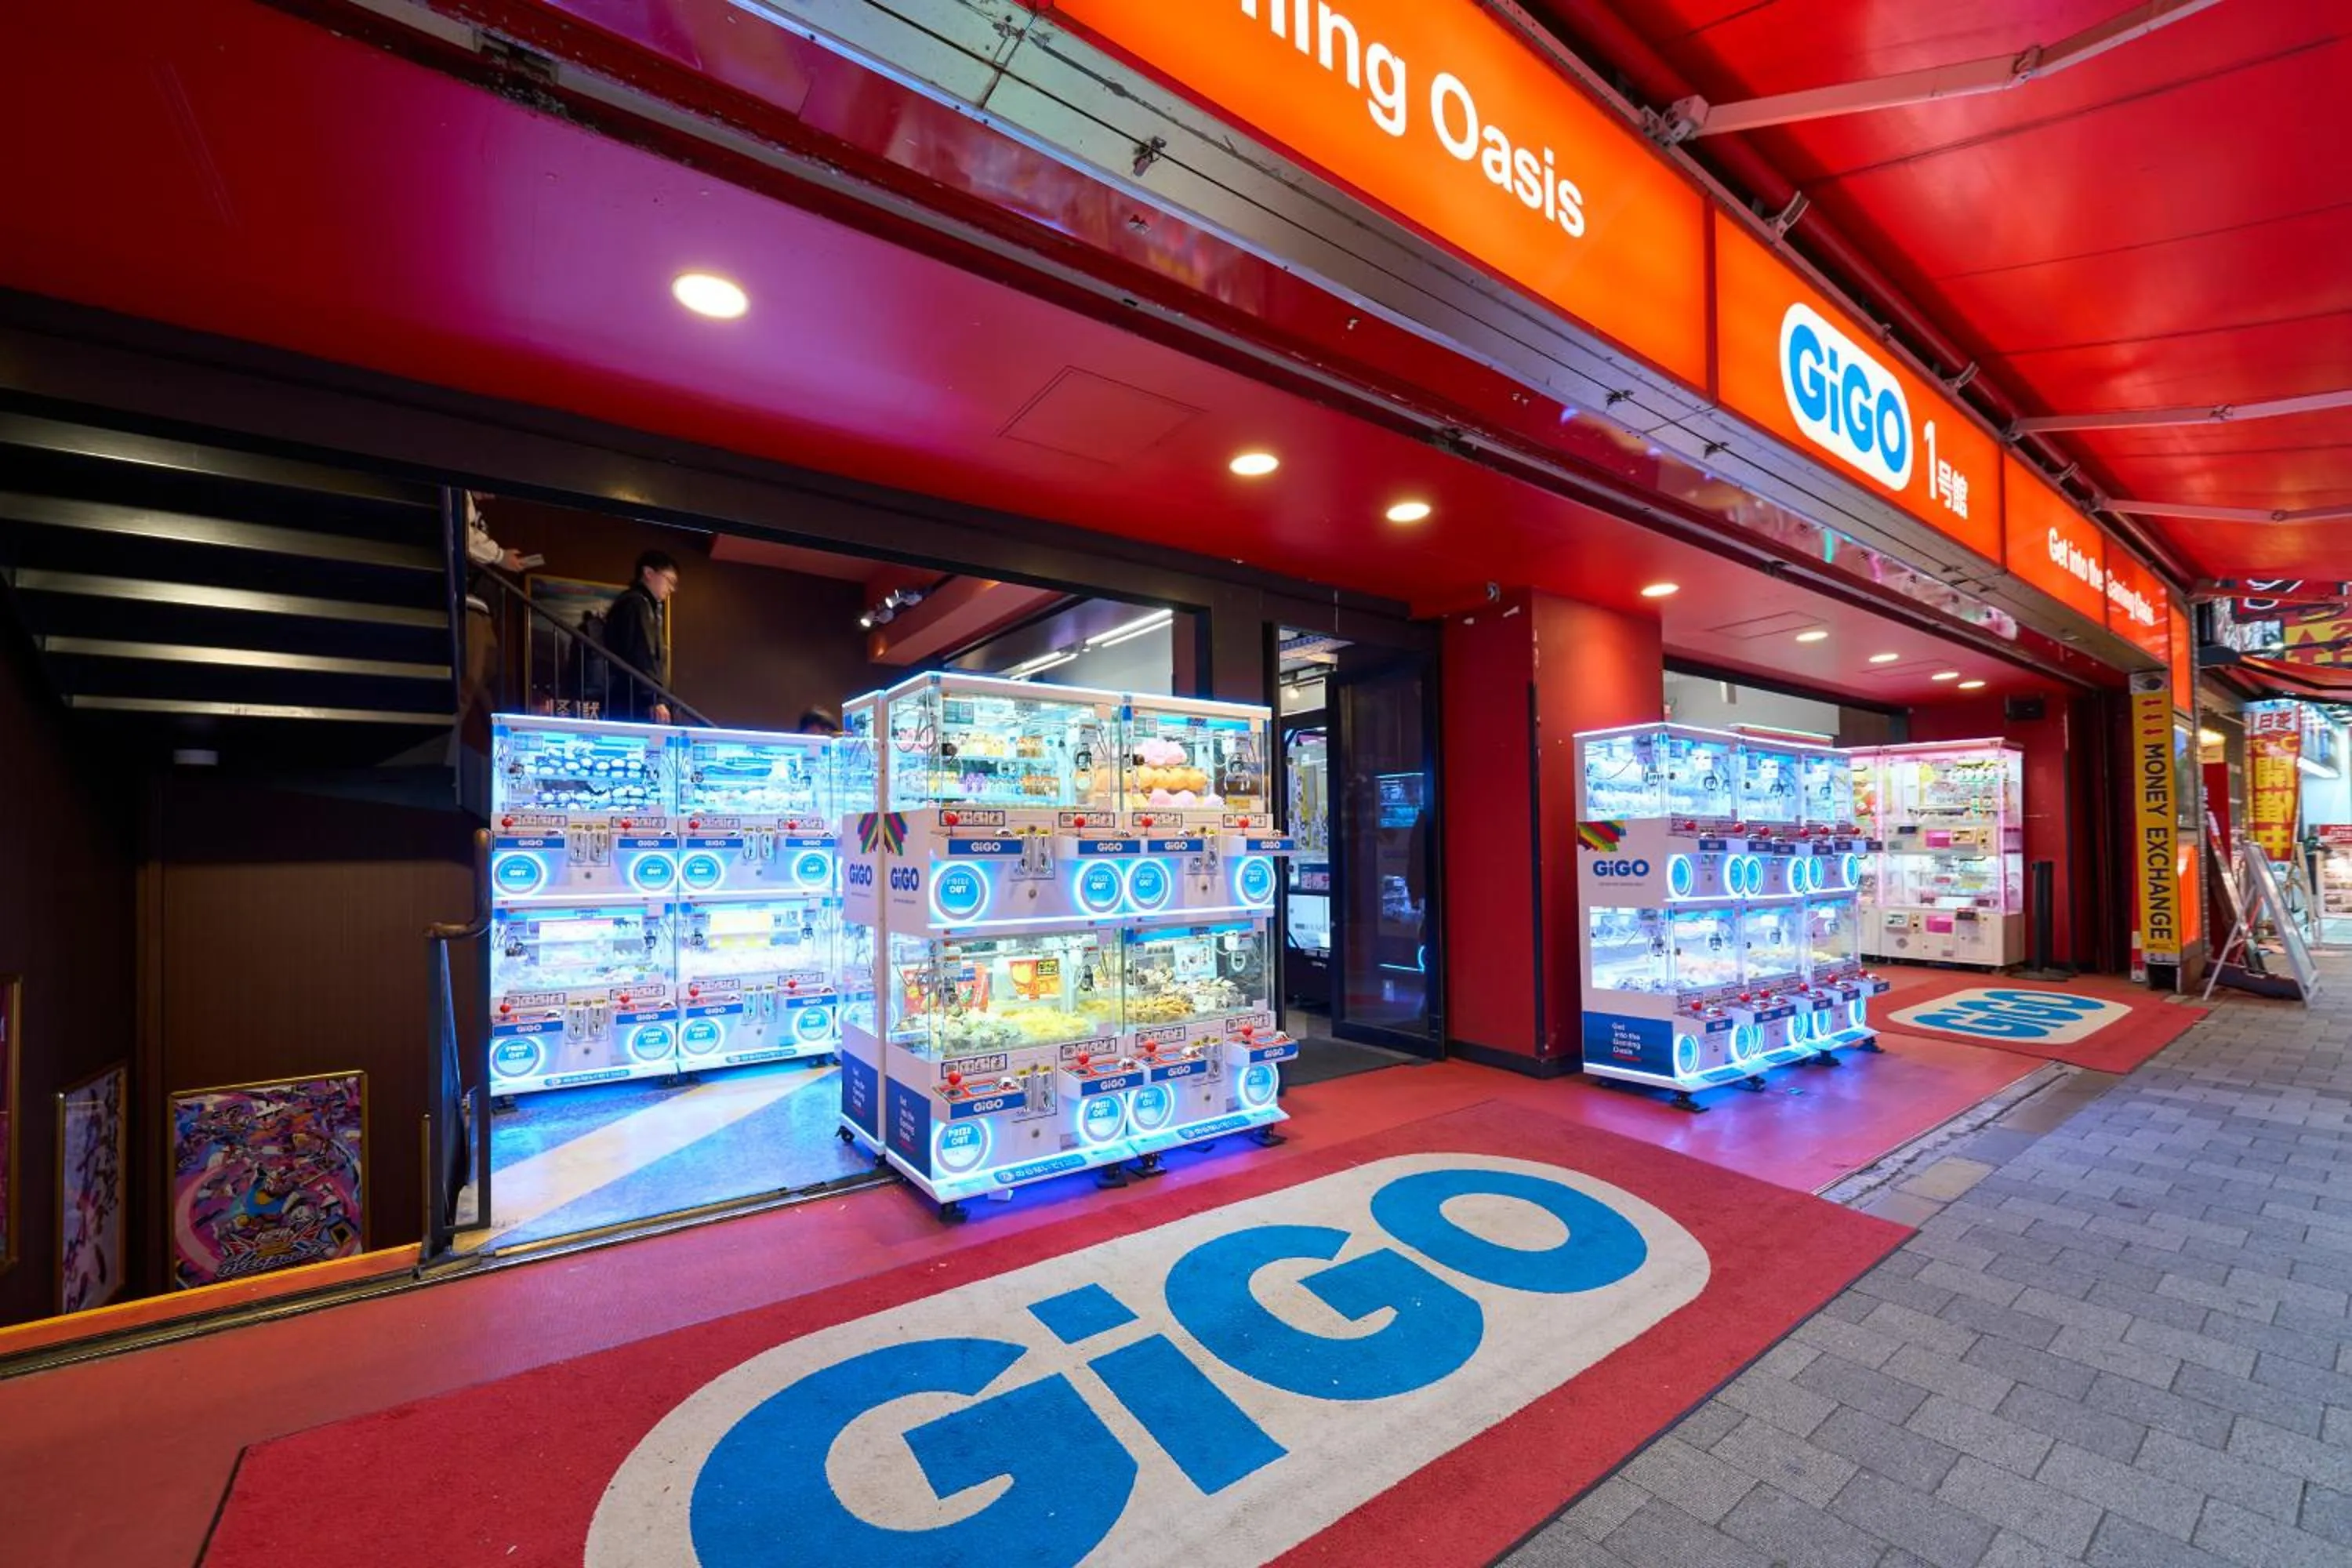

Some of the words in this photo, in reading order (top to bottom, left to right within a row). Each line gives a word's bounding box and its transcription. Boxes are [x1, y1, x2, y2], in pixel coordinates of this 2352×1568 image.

[1430, 72, 1584, 238] Oasis
[1789, 323, 1907, 474] GiGO
[2143, 742, 2169, 817] MONEY
[970, 841, 1001, 852] GiGO
[849, 864, 873, 886] GiGO
[891, 867, 920, 891] GiGO
[1592, 859, 1650, 877] GiGO
[2146, 827, 2172, 940] EXCHANGE
[1912, 990, 2106, 1038] GiGO
[1100, 1077, 1126, 1091] GiGO
[973, 1098, 1004, 1112] GiGO
[690, 1168, 1648, 1568] GiGO
